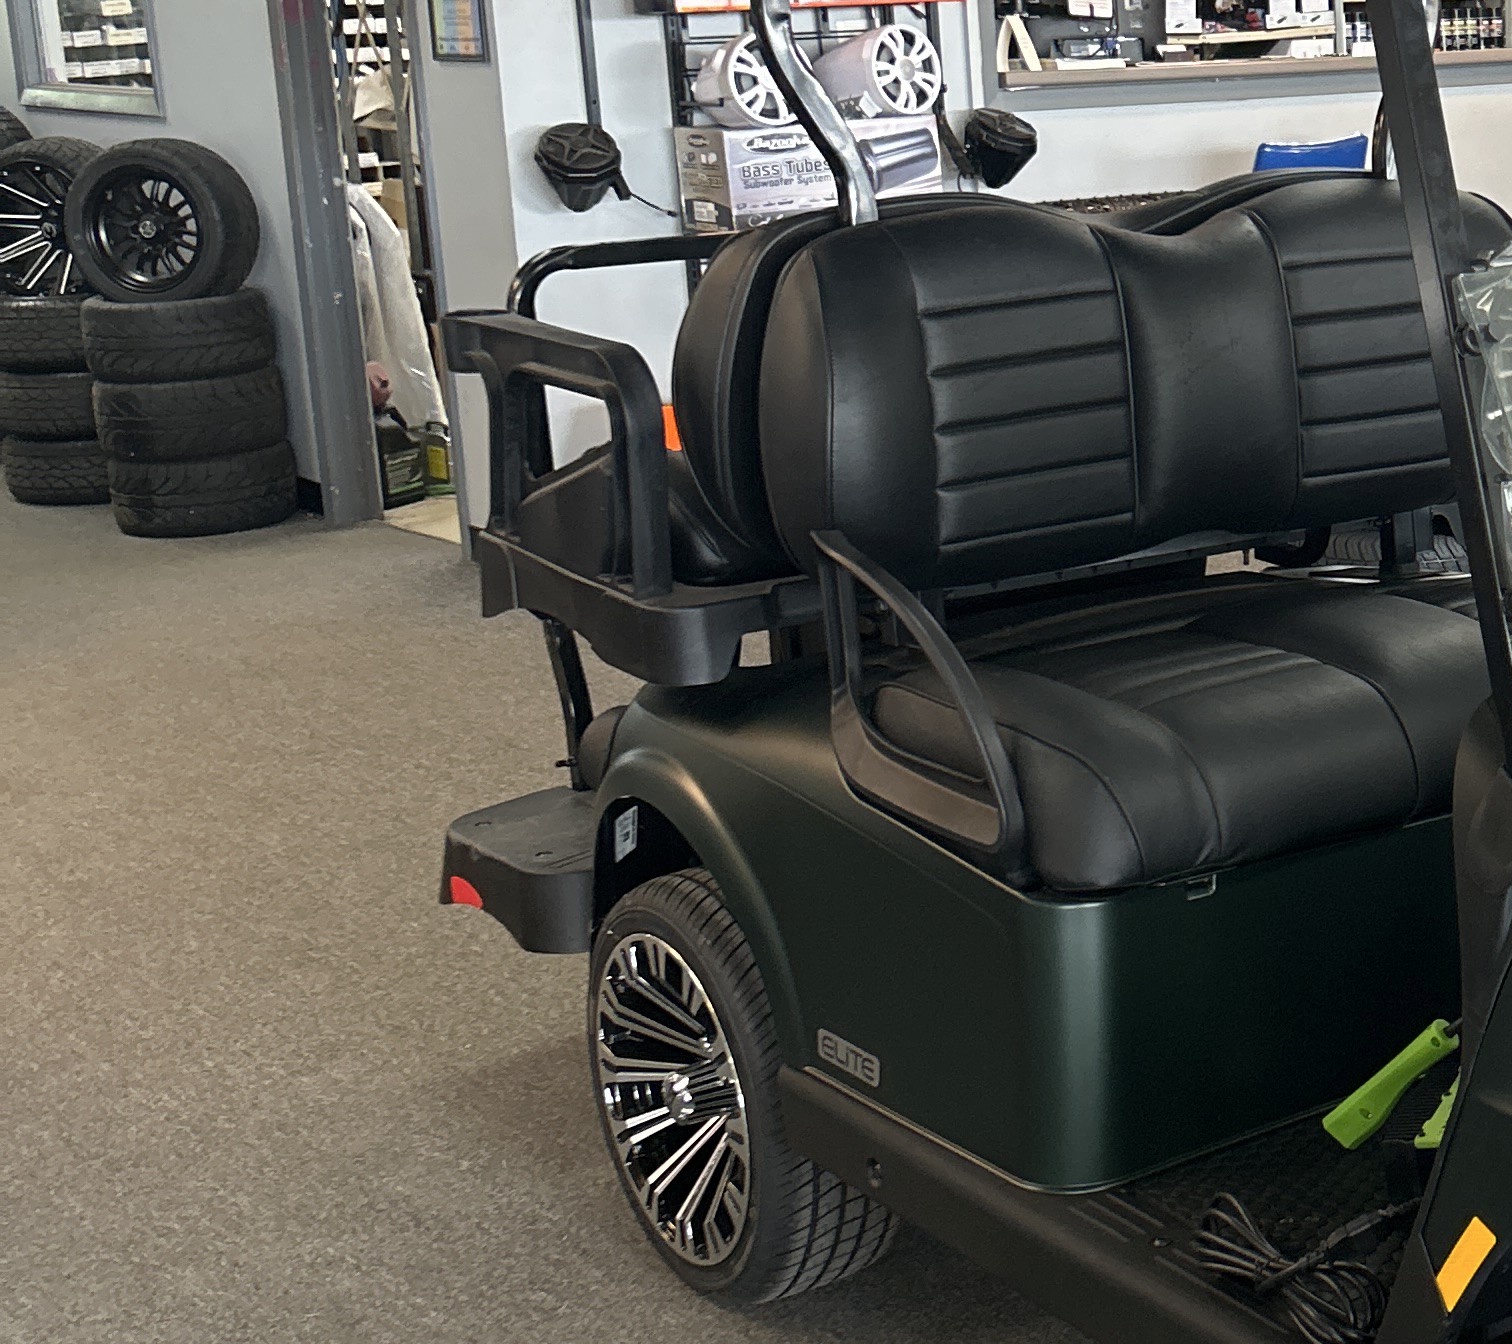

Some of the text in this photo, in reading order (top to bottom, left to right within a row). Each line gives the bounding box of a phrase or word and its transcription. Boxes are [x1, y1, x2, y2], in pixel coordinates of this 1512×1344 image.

[741, 158, 831, 179] Bass Tubes
[743, 175, 832, 189] Subwoofer System
[822, 1035, 875, 1081] ELITE
